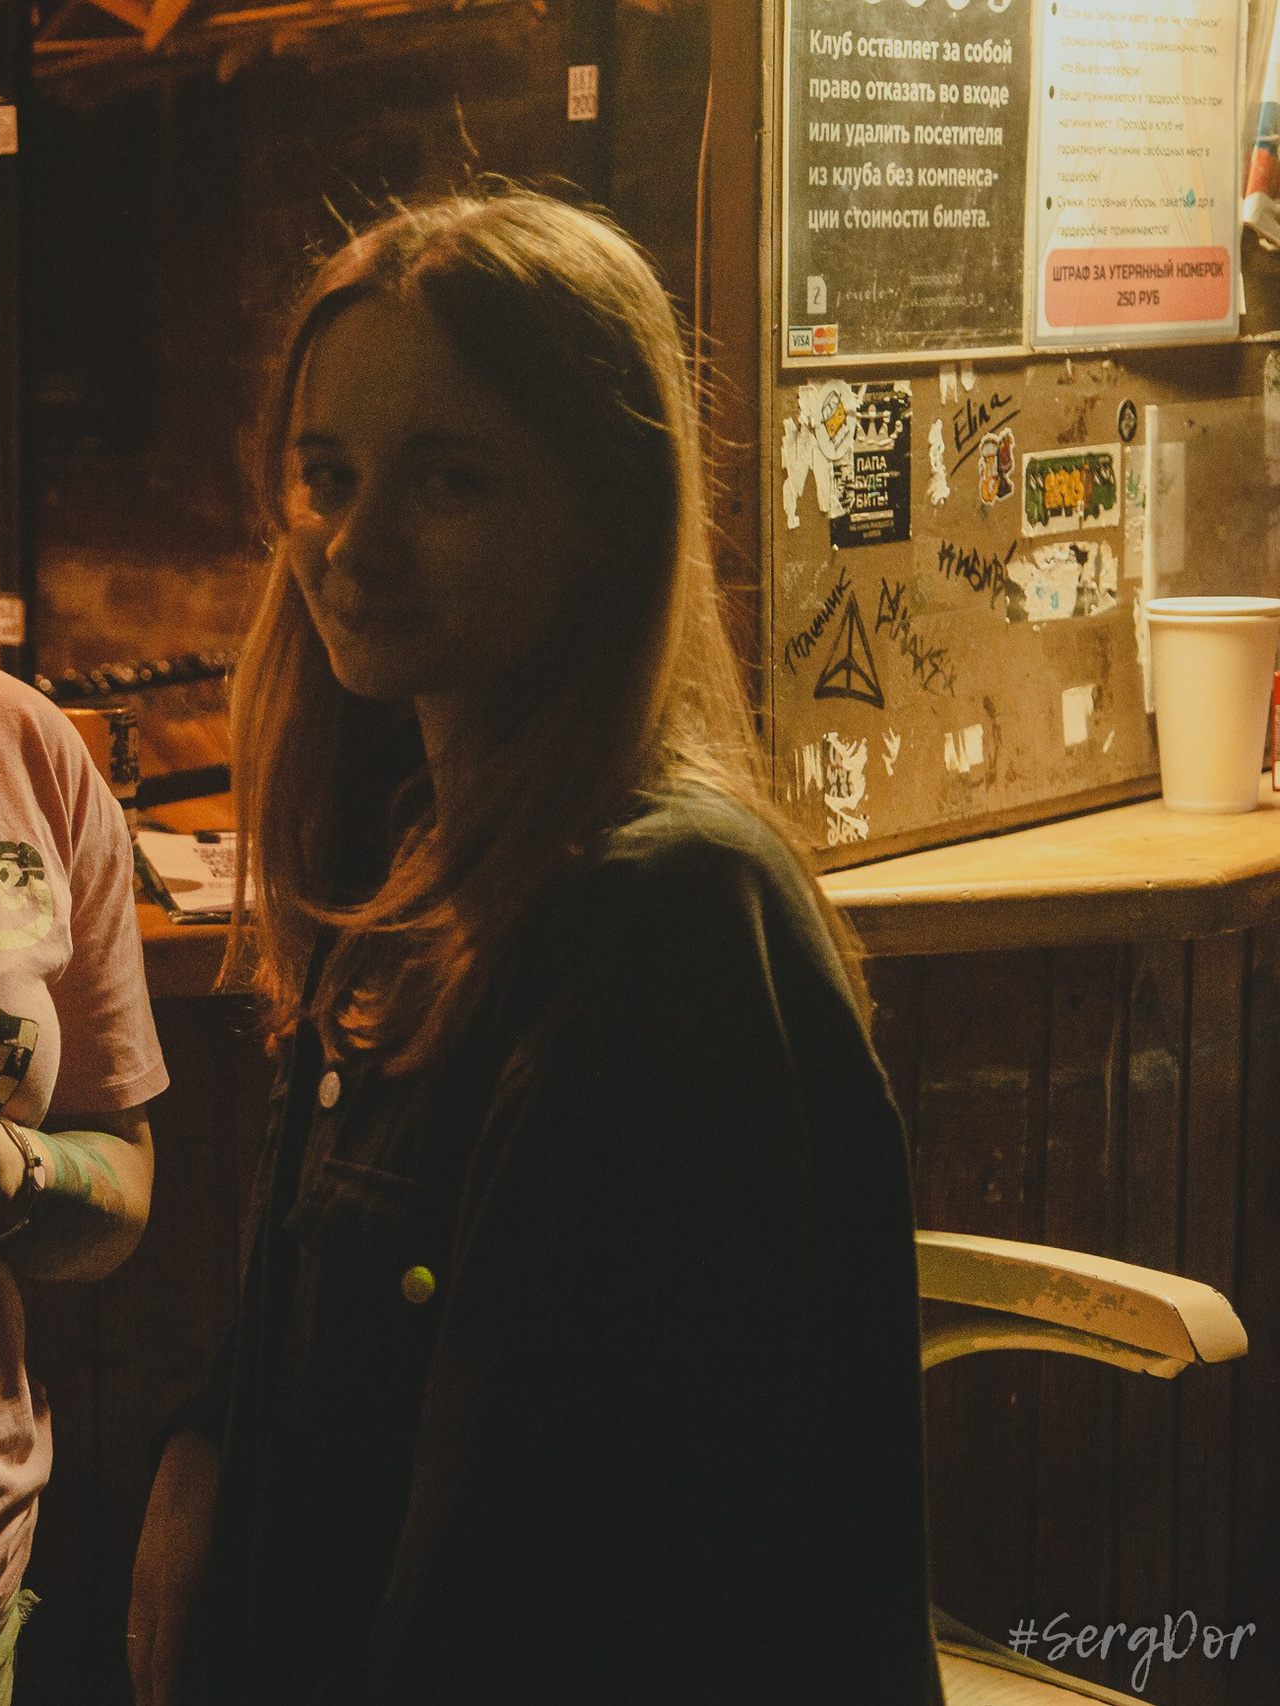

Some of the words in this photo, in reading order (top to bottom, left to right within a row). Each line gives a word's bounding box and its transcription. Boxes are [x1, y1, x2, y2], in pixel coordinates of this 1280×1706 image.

[810, 29, 852, 60] Клуб
[857, 36, 939, 60] оставляет
[943, 40, 960, 61] за
[964, 38, 1012, 63] собой
[809, 78, 861, 103] право
[866, 80, 936, 103] отказать
[940, 84, 959, 103] во
[963, 84, 1010, 108] входе
[809, 122, 840, 141] или
[845, 123, 910, 147] удалить
[914, 125, 1003, 145] посетителя
[809, 166, 828, 185] из
[833, 161, 881, 190] клуба
[886, 161, 914, 186] без
[918, 167, 998, 187] компенса-
[808, 208, 839, 232] ции
[844, 208, 929, 229] стоимости
[933, 204, 990, 229] билета.
[1053, 265, 1091, 282] ШТРАФ
[1093, 265, 1106, 281] ЗА
[1109, 259, 1174, 280] УТЕРЯННЫЙ
[1176, 261, 1224, 278] НОМЕРОК
[1117, 291, 1136, 307] 250
[1139, 290, 1160, 305] РУБ
[793, 334, 810, 346] VISA
[857, 455, 888, 472] ПАПА
[855, 472, 889, 491] БУДЕТ
